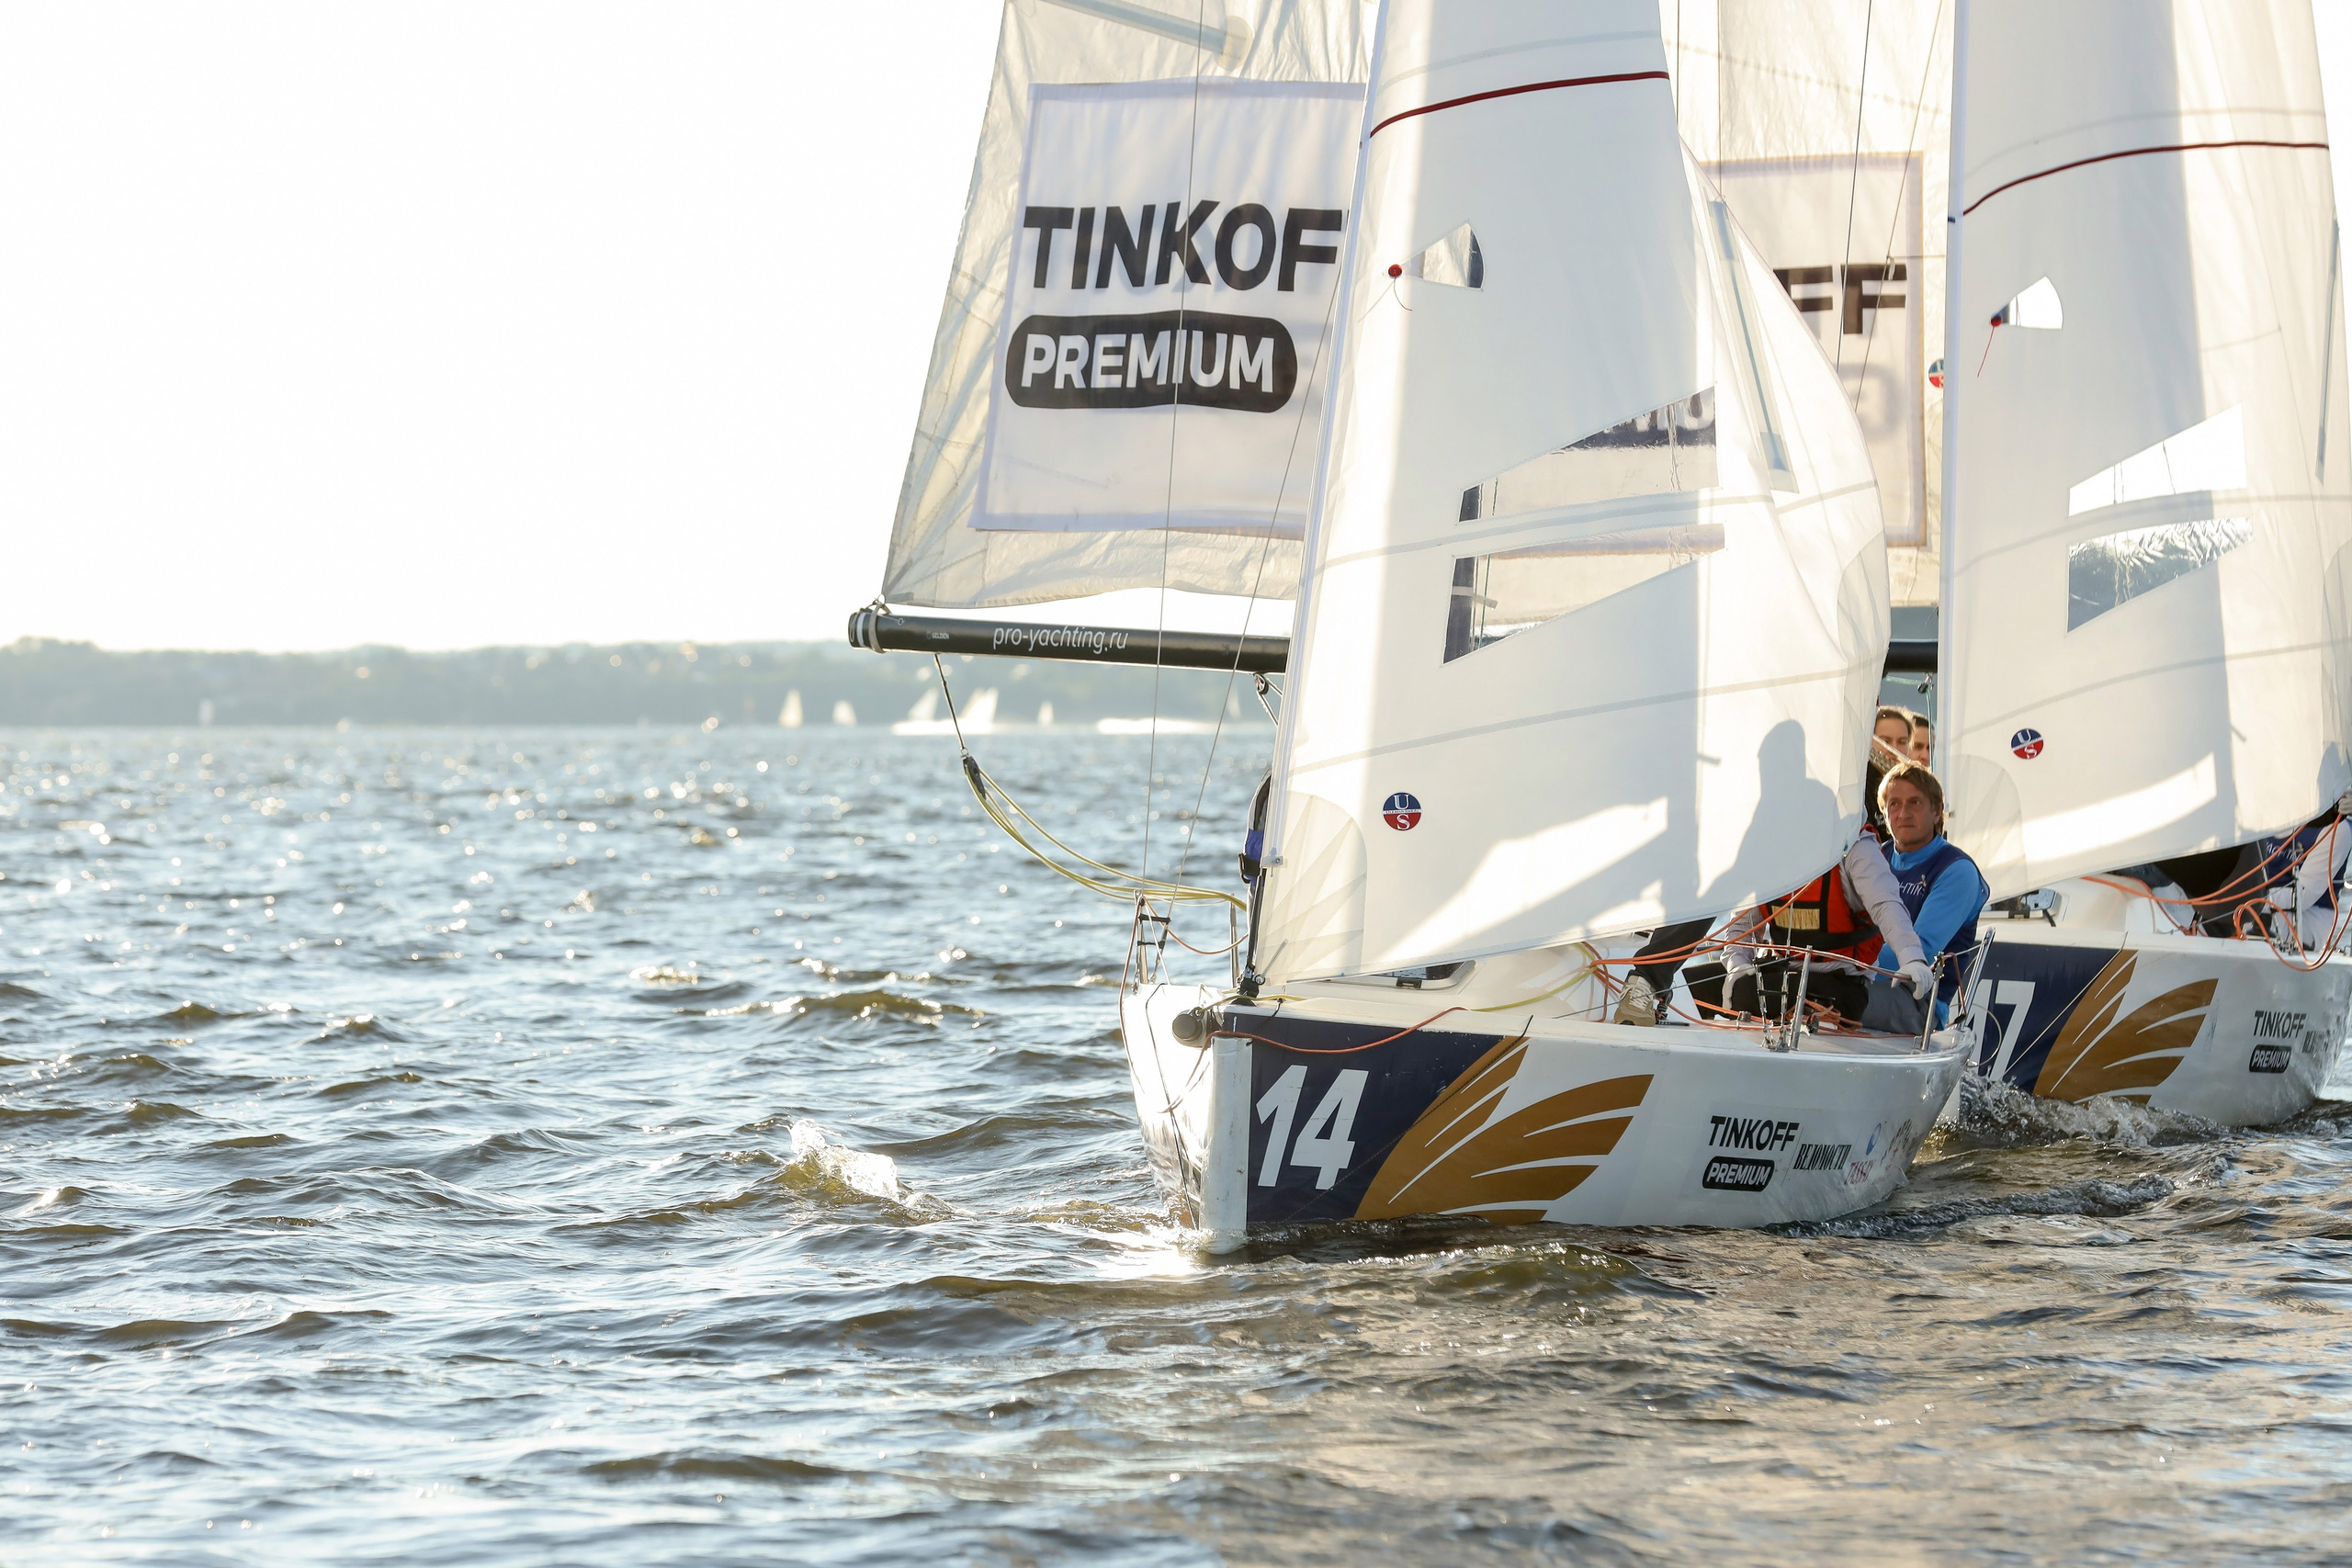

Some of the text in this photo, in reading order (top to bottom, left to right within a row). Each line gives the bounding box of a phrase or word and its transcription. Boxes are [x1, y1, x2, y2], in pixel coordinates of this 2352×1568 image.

[1023, 199, 1350, 292] TINKOF
[1021, 329, 1275, 393] PREMIUM
[993, 625, 1129, 655] pro-yachting.ru
[1963, 978, 2036, 1082] 17
[2254, 1010, 2307, 1039] TINKOFF
[2252, 1050, 2290, 1068] PREMIUM
[1256, 1065, 1369, 1190] 14
[1709, 1115, 1800, 1152] TINKOFF
[1706, 1162, 1772, 1186] PREMIUM
[1792, 1144, 1852, 1173] ВЕДОМОСТИ
